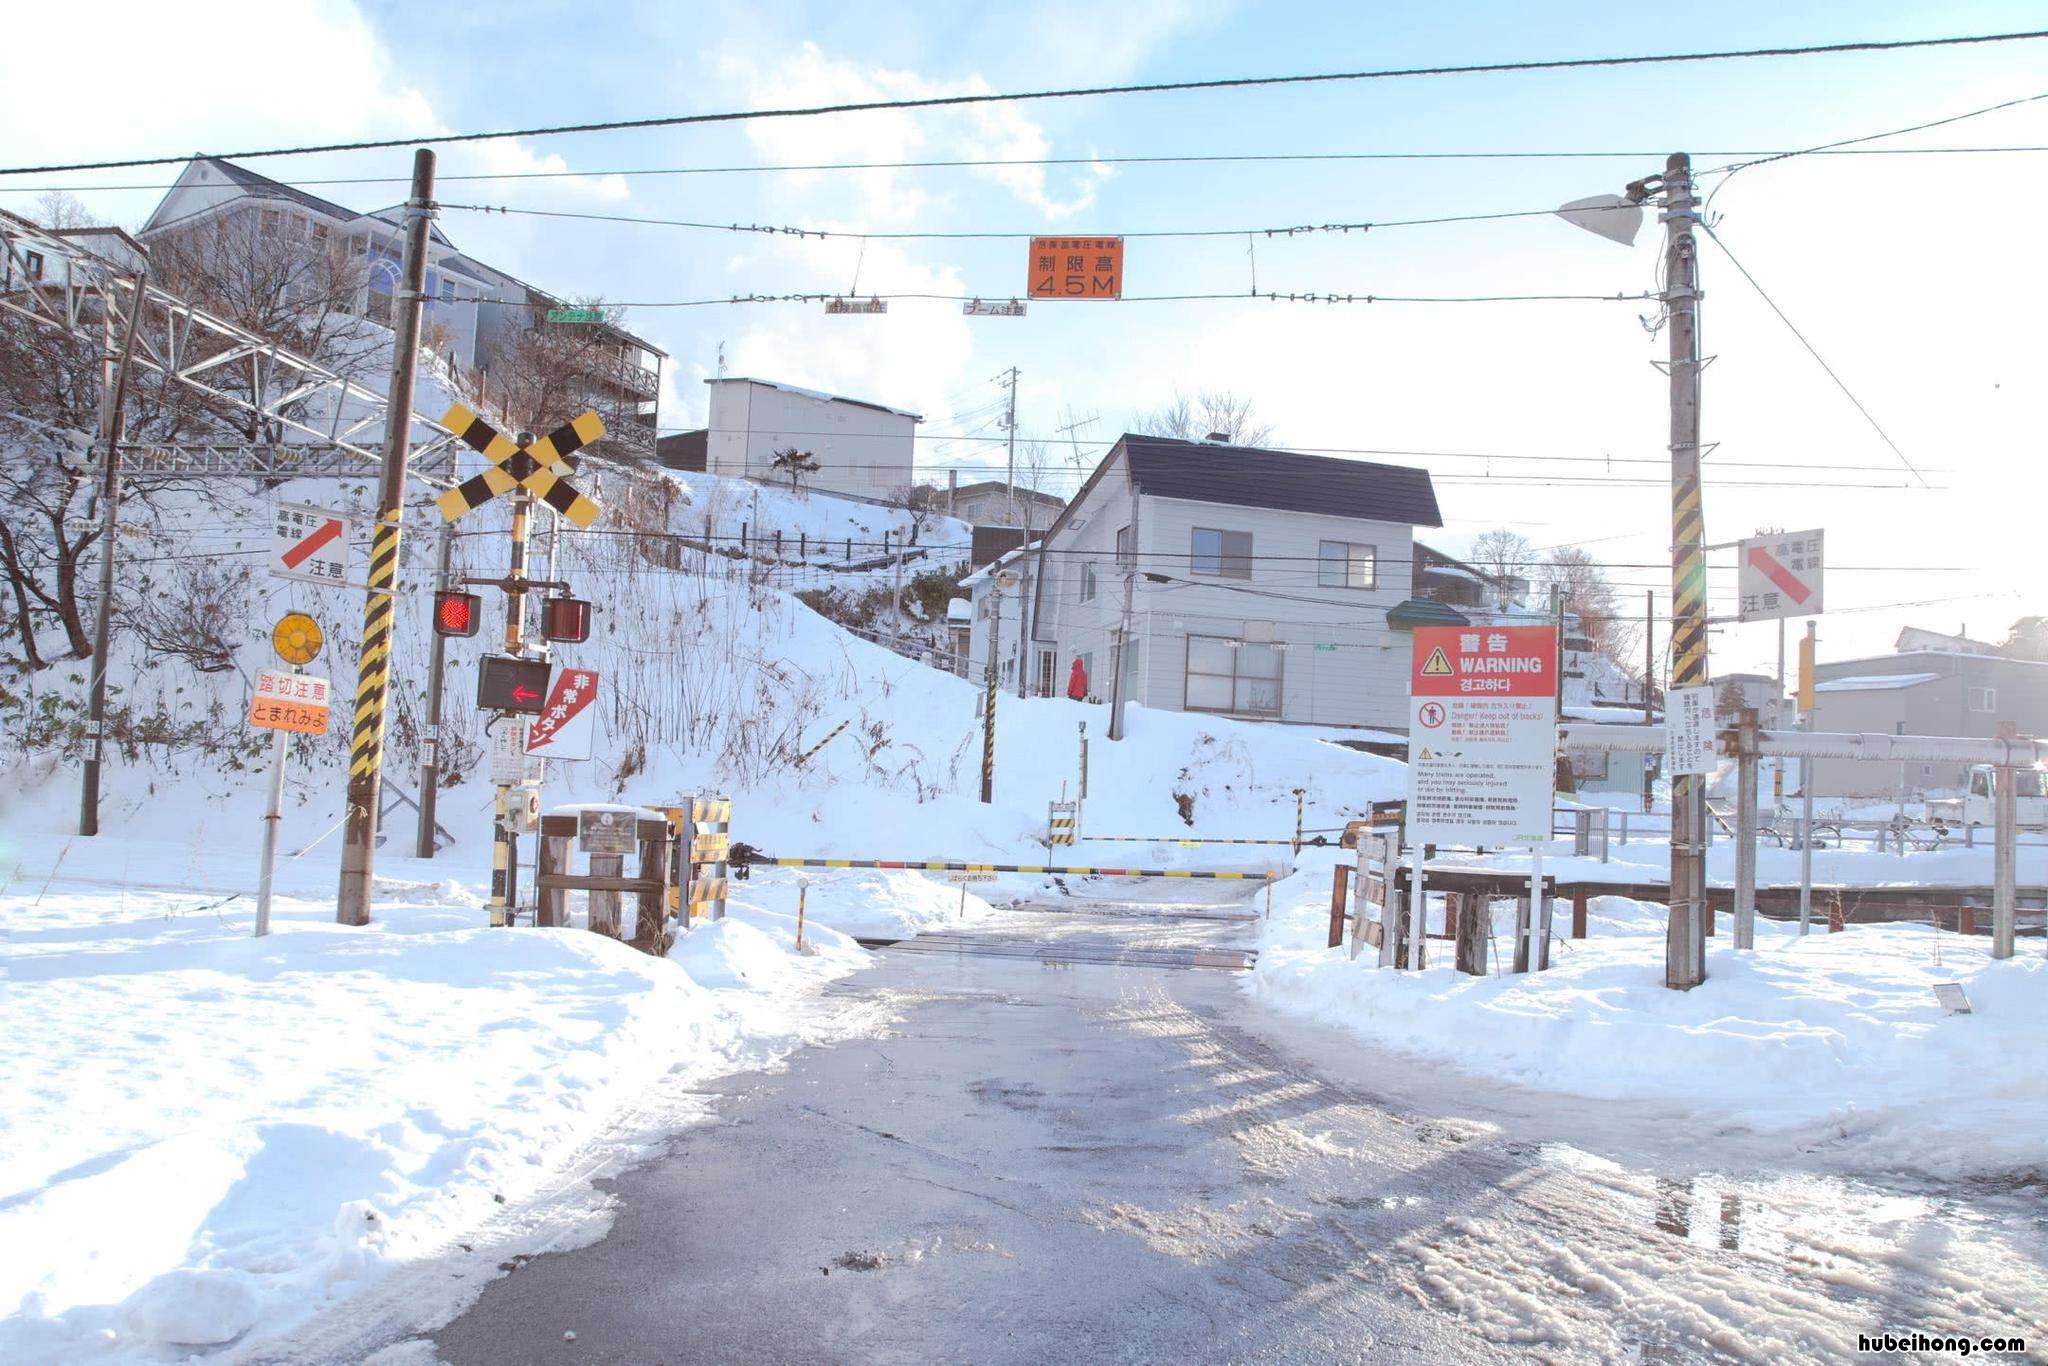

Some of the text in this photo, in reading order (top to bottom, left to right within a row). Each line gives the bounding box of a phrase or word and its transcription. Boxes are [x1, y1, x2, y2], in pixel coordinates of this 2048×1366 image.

[1039, 256, 1113, 272] 制限高
[1037, 276, 1114, 295] 4.5M
[278, 510, 317, 527] 高電圧
[277, 525, 302, 539] 電線
[1776, 540, 1820, 556] 高電圧
[309, 558, 344, 578] 注意
[1741, 592, 1780, 613] 注意
[1460, 633, 1508, 652] 警告
[1460, 657, 1541, 673] WARNING
[259, 674, 326, 700] 踏切注意
[1460, 678, 1511, 692] 경고하다
[253, 703, 325, 728] とまれみよ
[531, 673, 590, 743] 非常ボタン
[1417, 771, 1434, 779] Many
